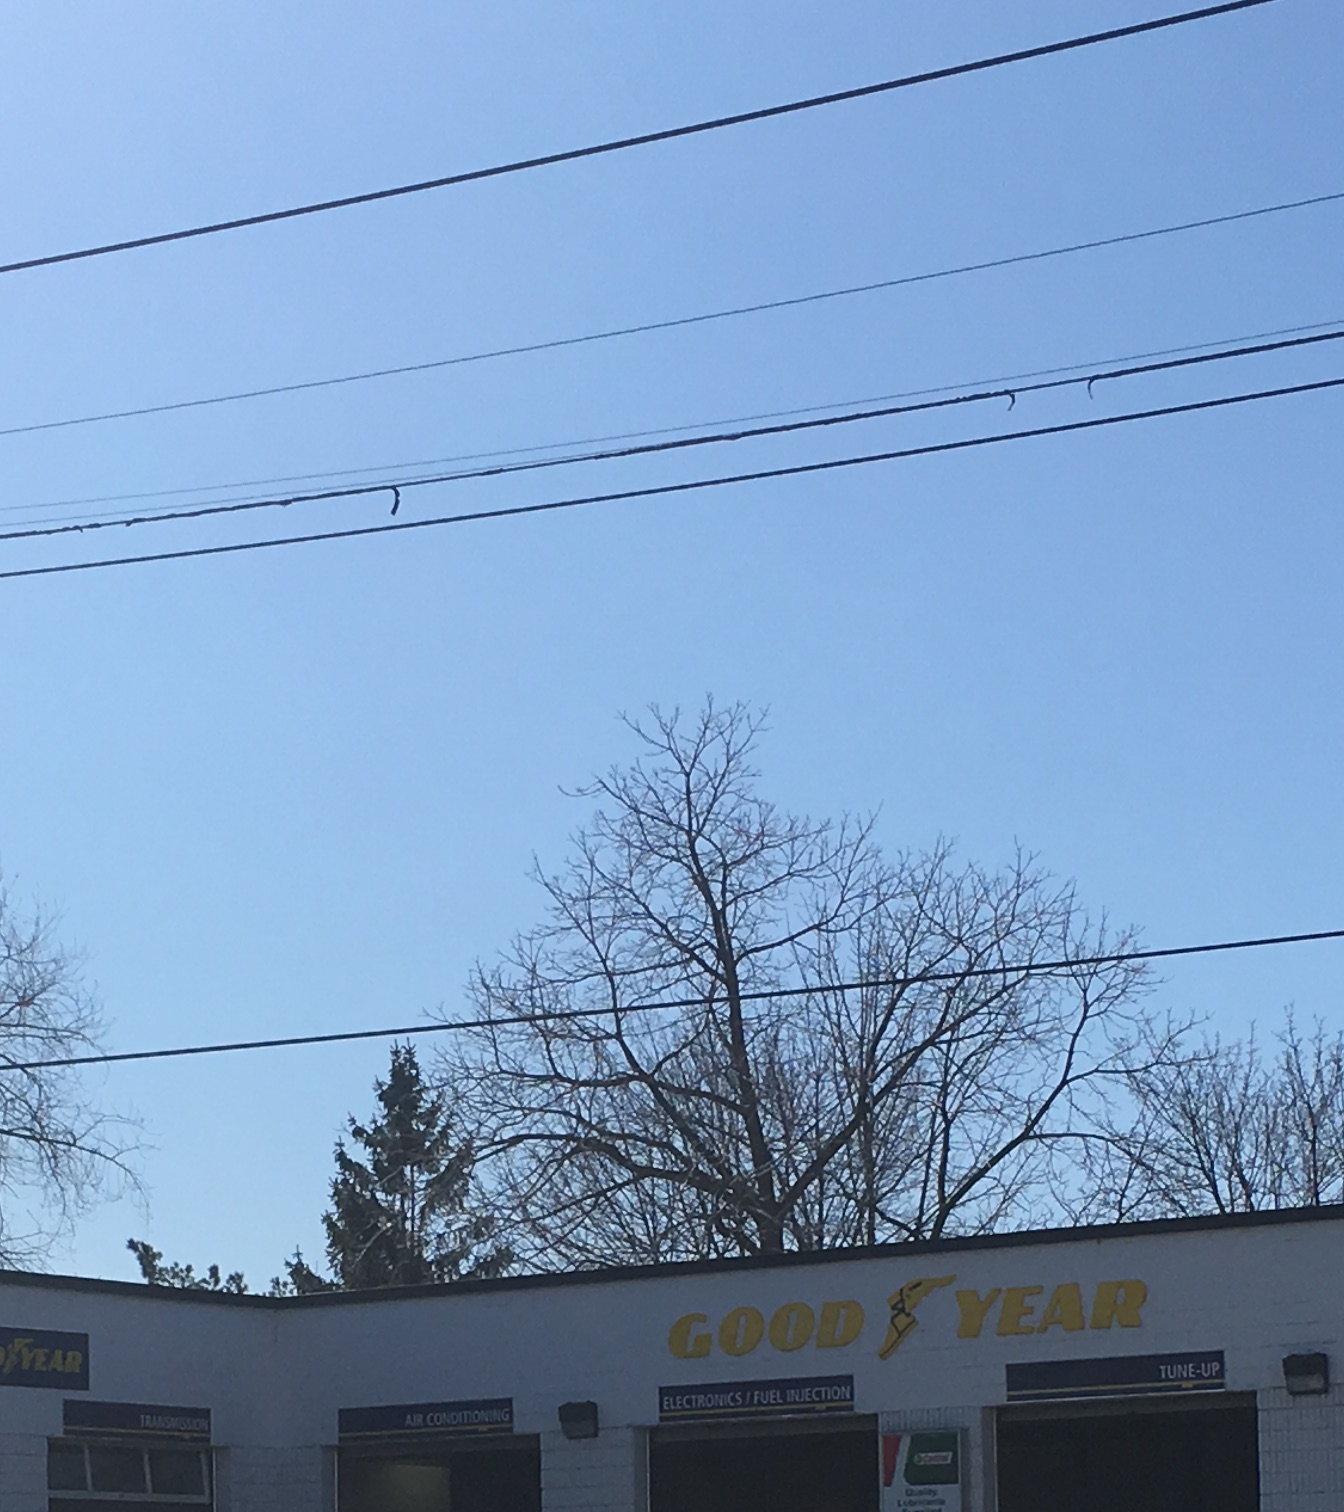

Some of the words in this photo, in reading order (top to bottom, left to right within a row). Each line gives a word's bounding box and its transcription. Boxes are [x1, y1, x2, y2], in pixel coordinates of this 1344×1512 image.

[668, 1300, 865, 1358] GOOD
[956, 1279, 1148, 1338] YEAR
[1159, 1361, 1220, 1379] TUNE-UP
[663, 1391, 742, 1410] ELECTRONICS
[754, 1389, 783, 1404] FUEL
[786, 1385, 851, 1402] INJECTION
[140, 1414, 209, 1431] TRANSMISSION
[405, 1413, 424, 1427] AIR
[426, 1408, 511, 1426] CONDITIONING
